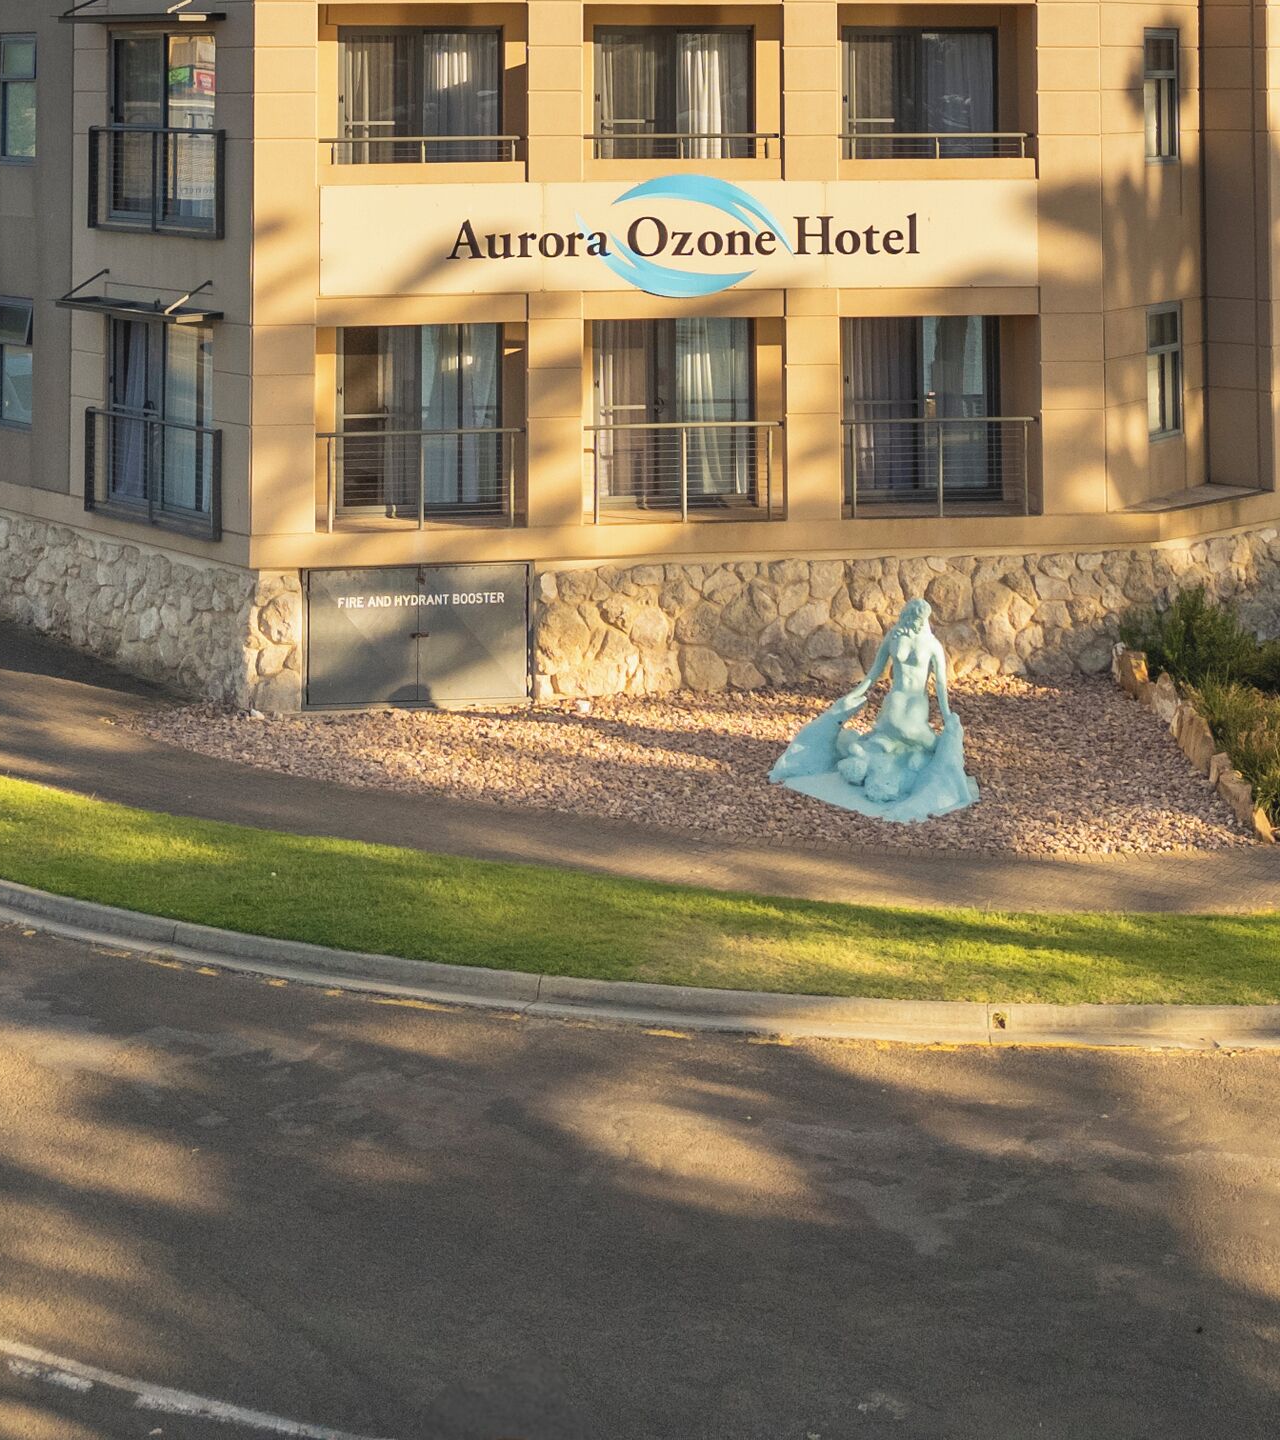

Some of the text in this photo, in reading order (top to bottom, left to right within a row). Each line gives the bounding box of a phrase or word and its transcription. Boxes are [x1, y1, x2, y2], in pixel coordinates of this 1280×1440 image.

[447, 213, 921, 261] Aurora Ozone Hotel
[337, 592, 505, 609] FIRE AND HYDRANT BOOSTER
